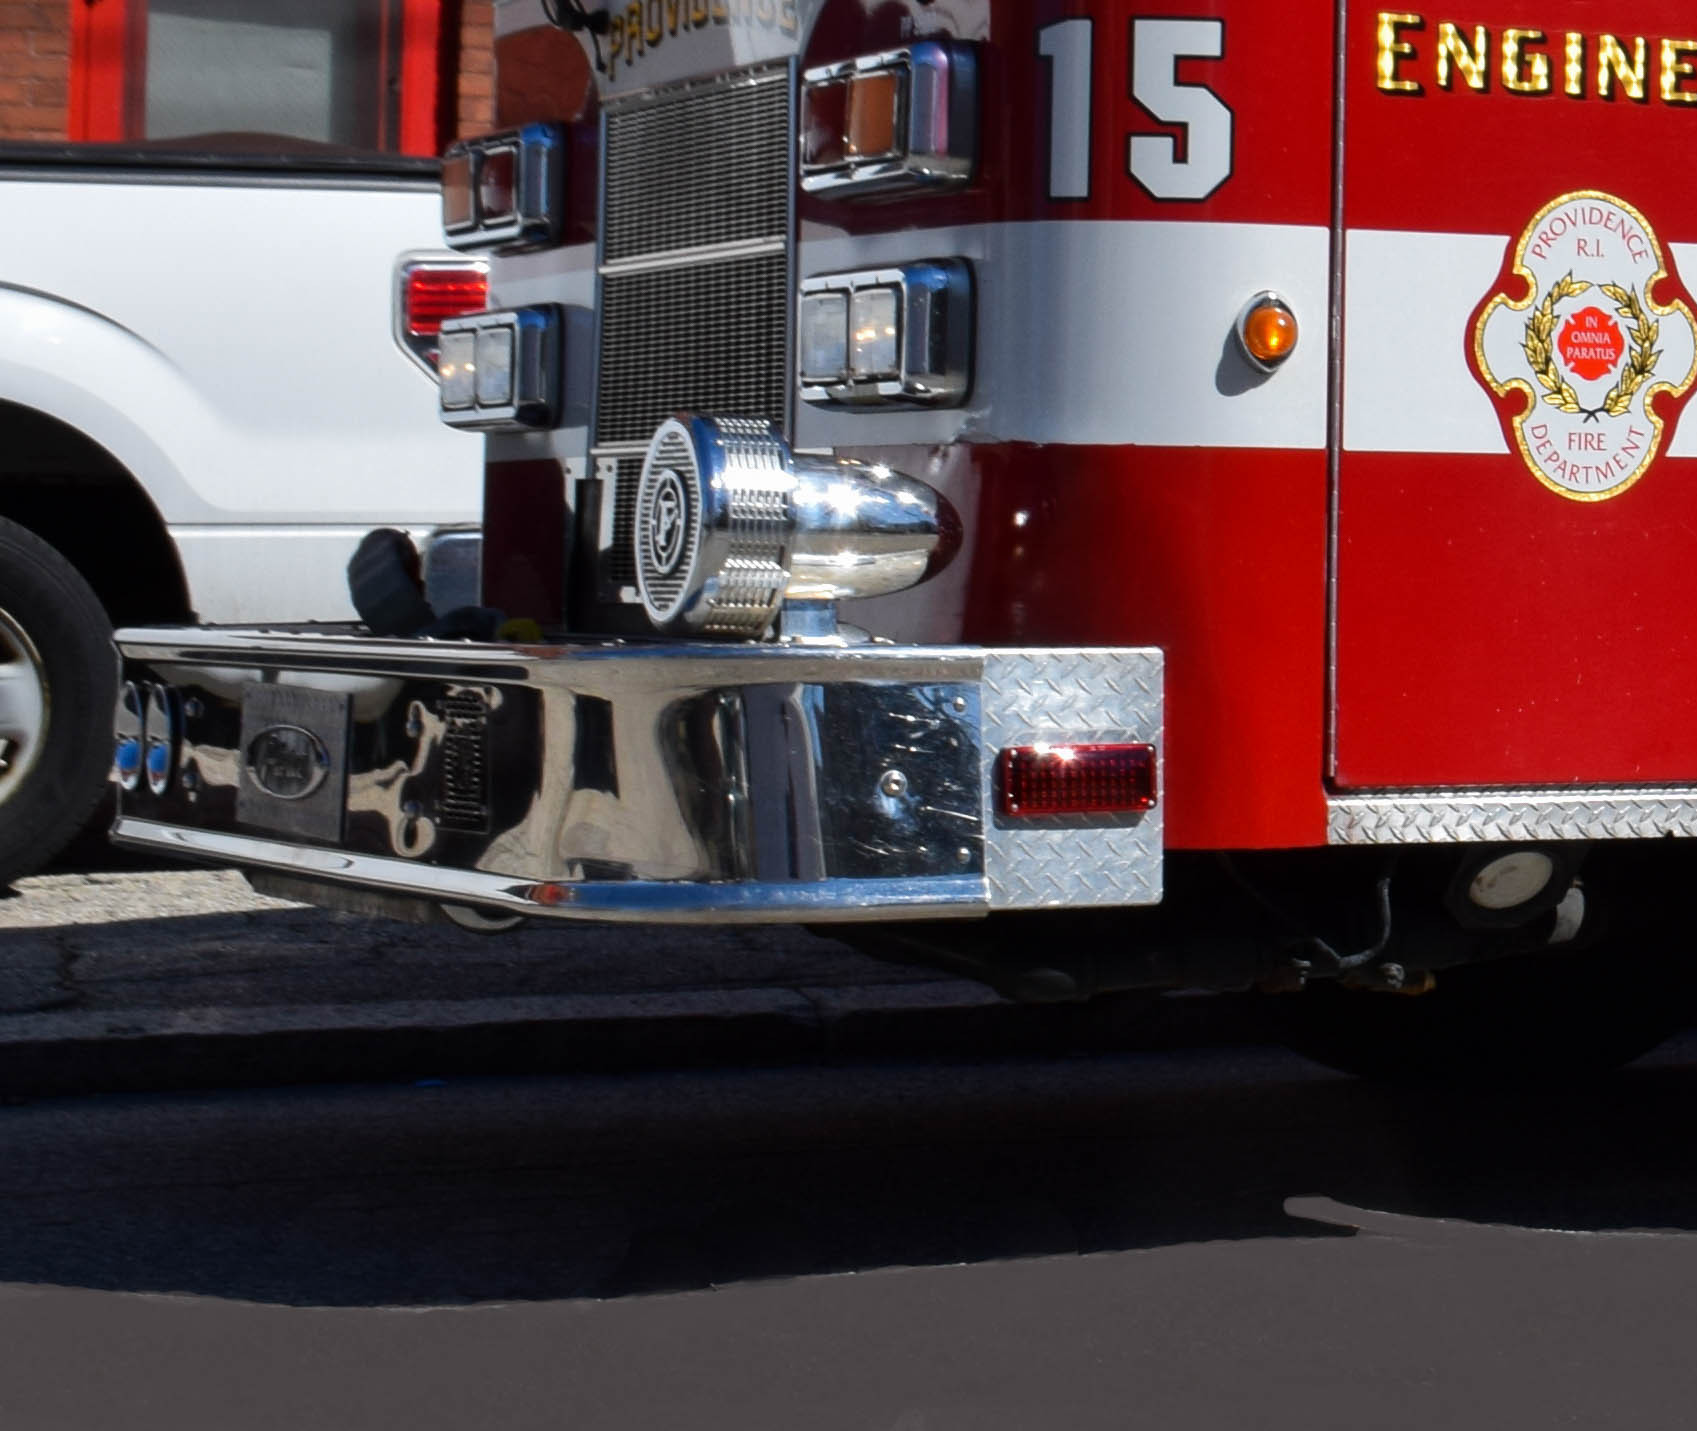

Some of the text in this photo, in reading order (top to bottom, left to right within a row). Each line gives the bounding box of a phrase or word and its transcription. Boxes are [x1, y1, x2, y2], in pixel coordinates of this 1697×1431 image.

[1037, 17, 1234, 201] 15
[1531, 206, 1650, 265] PROVIDENCE
[1576, 237, 1605, 258] R.I.
[1584, 315, 1599, 328] IN
[1570, 331, 1612, 345] OMNIA
[1566, 346, 1616, 362] PARATUS
[1567, 432, 1608, 452] FIRE
[1531, 423, 1646, 485] DEPARTMENT
